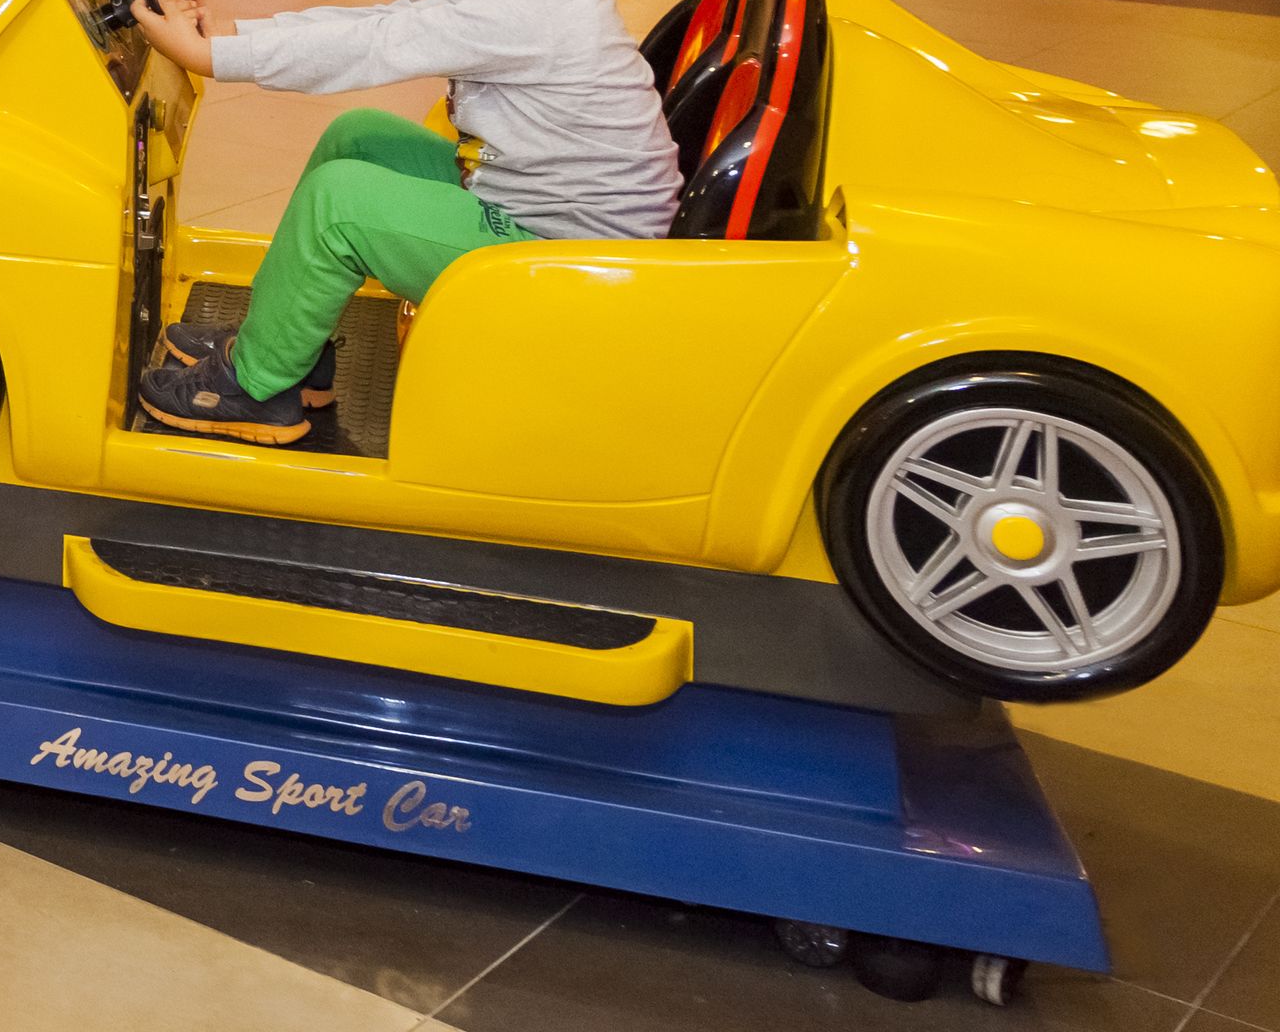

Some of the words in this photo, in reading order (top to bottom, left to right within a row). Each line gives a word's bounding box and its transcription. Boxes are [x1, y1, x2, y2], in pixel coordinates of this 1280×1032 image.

[30, 727, 219, 805] Amazing
[235, 760, 368, 815] Sport
[382, 779, 472, 833] Car
